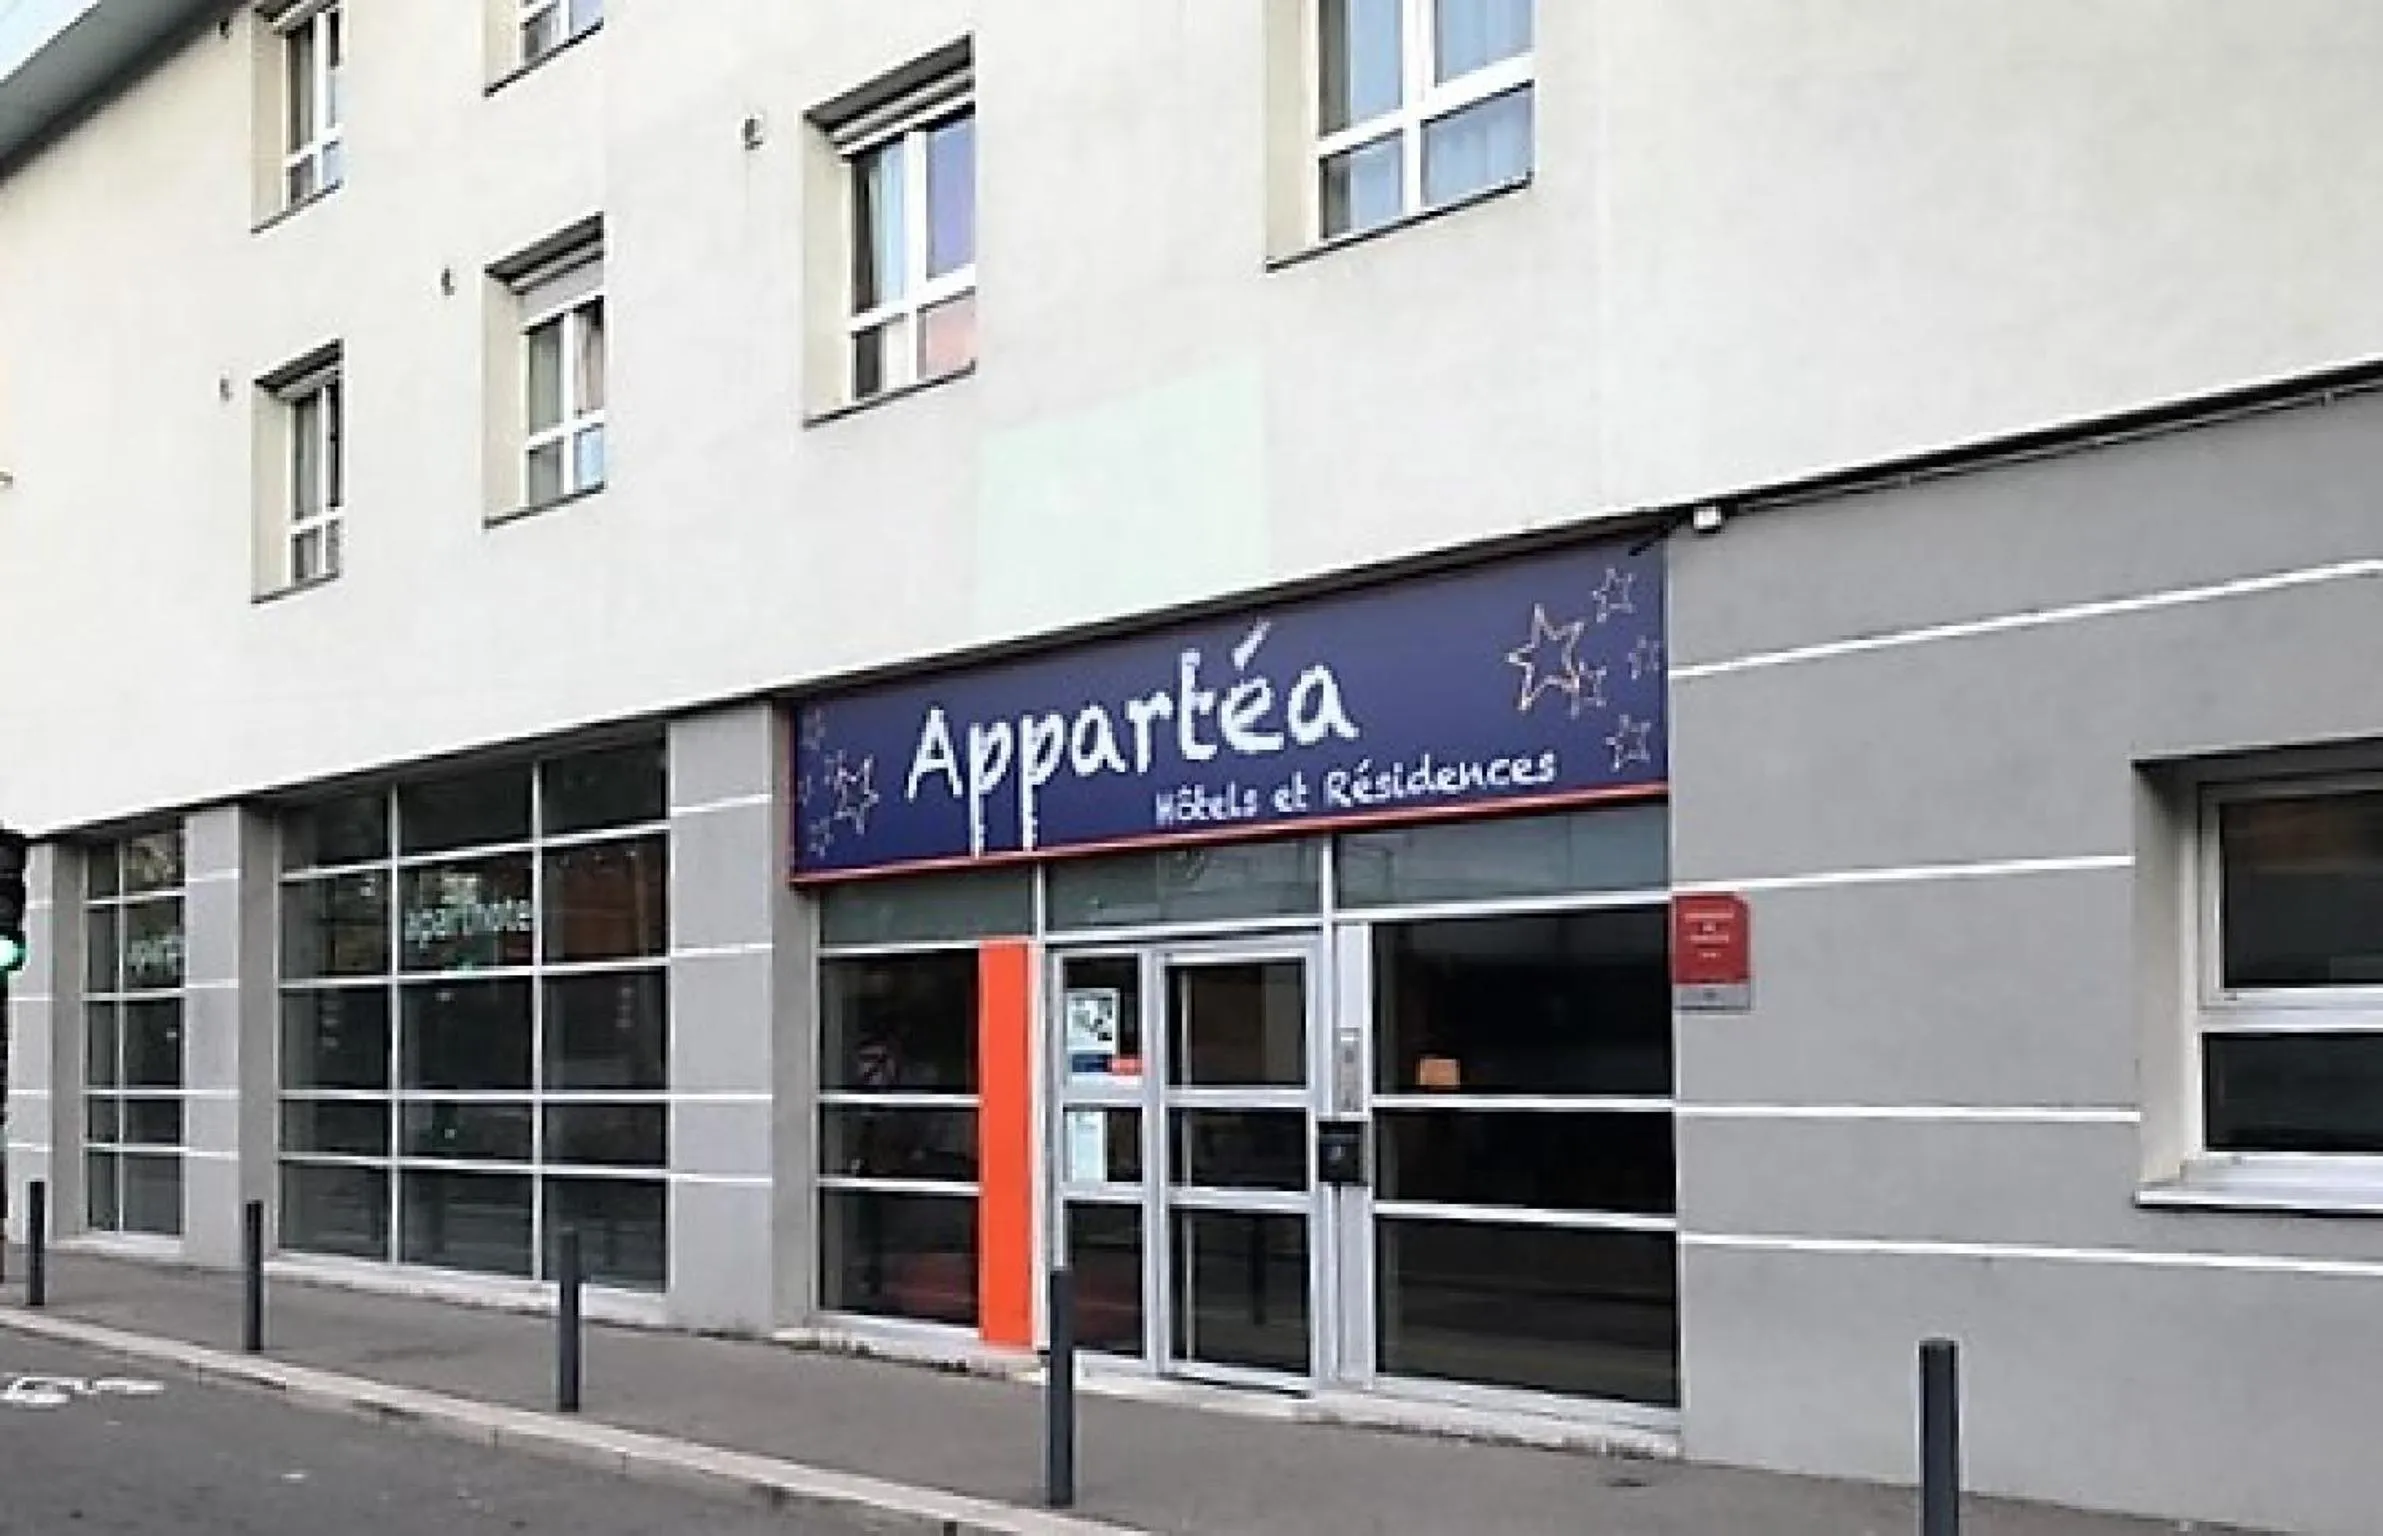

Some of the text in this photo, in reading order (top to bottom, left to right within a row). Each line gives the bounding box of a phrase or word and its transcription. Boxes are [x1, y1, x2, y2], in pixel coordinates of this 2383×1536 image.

[906, 617, 1359, 857] Appartéa
[1155, 752, 1557, 826] Hôtels et Résidences
